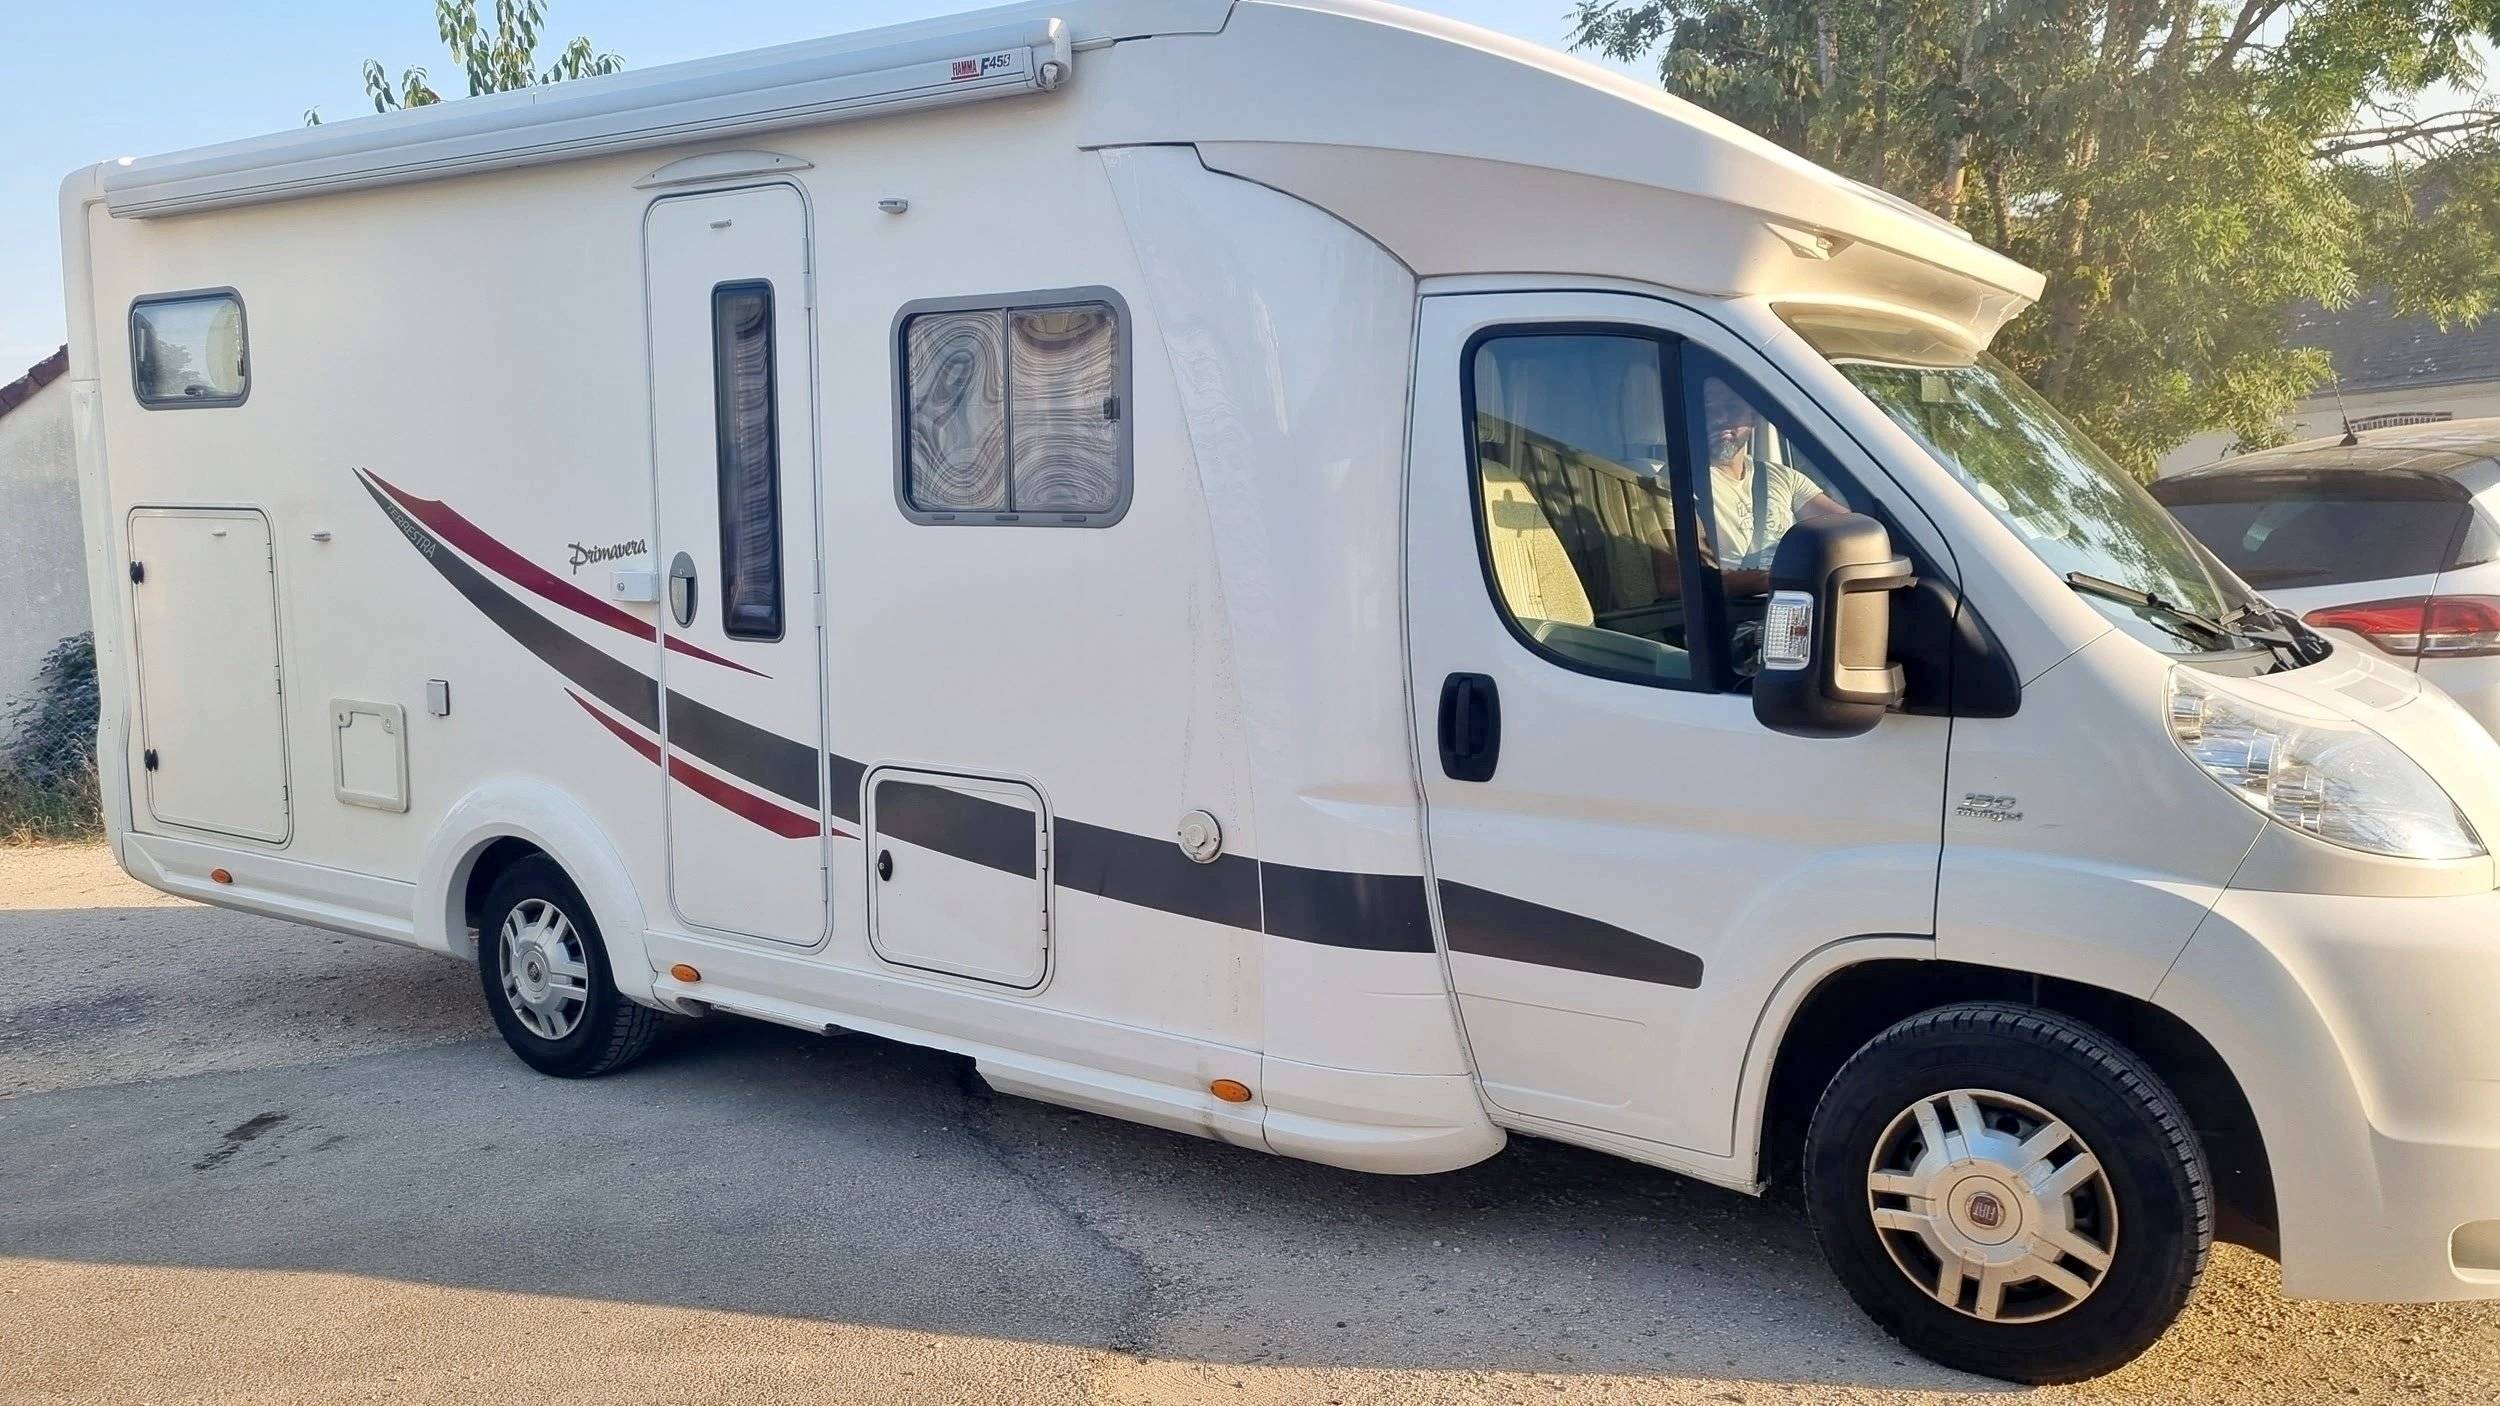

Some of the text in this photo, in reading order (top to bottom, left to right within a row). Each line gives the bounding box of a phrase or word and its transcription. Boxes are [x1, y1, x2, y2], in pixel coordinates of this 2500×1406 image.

[952, 59, 978, 77] FIAMMA
[386, 503, 437, 558] TERRESTRA
[567, 538, 648, 575] Primavera
